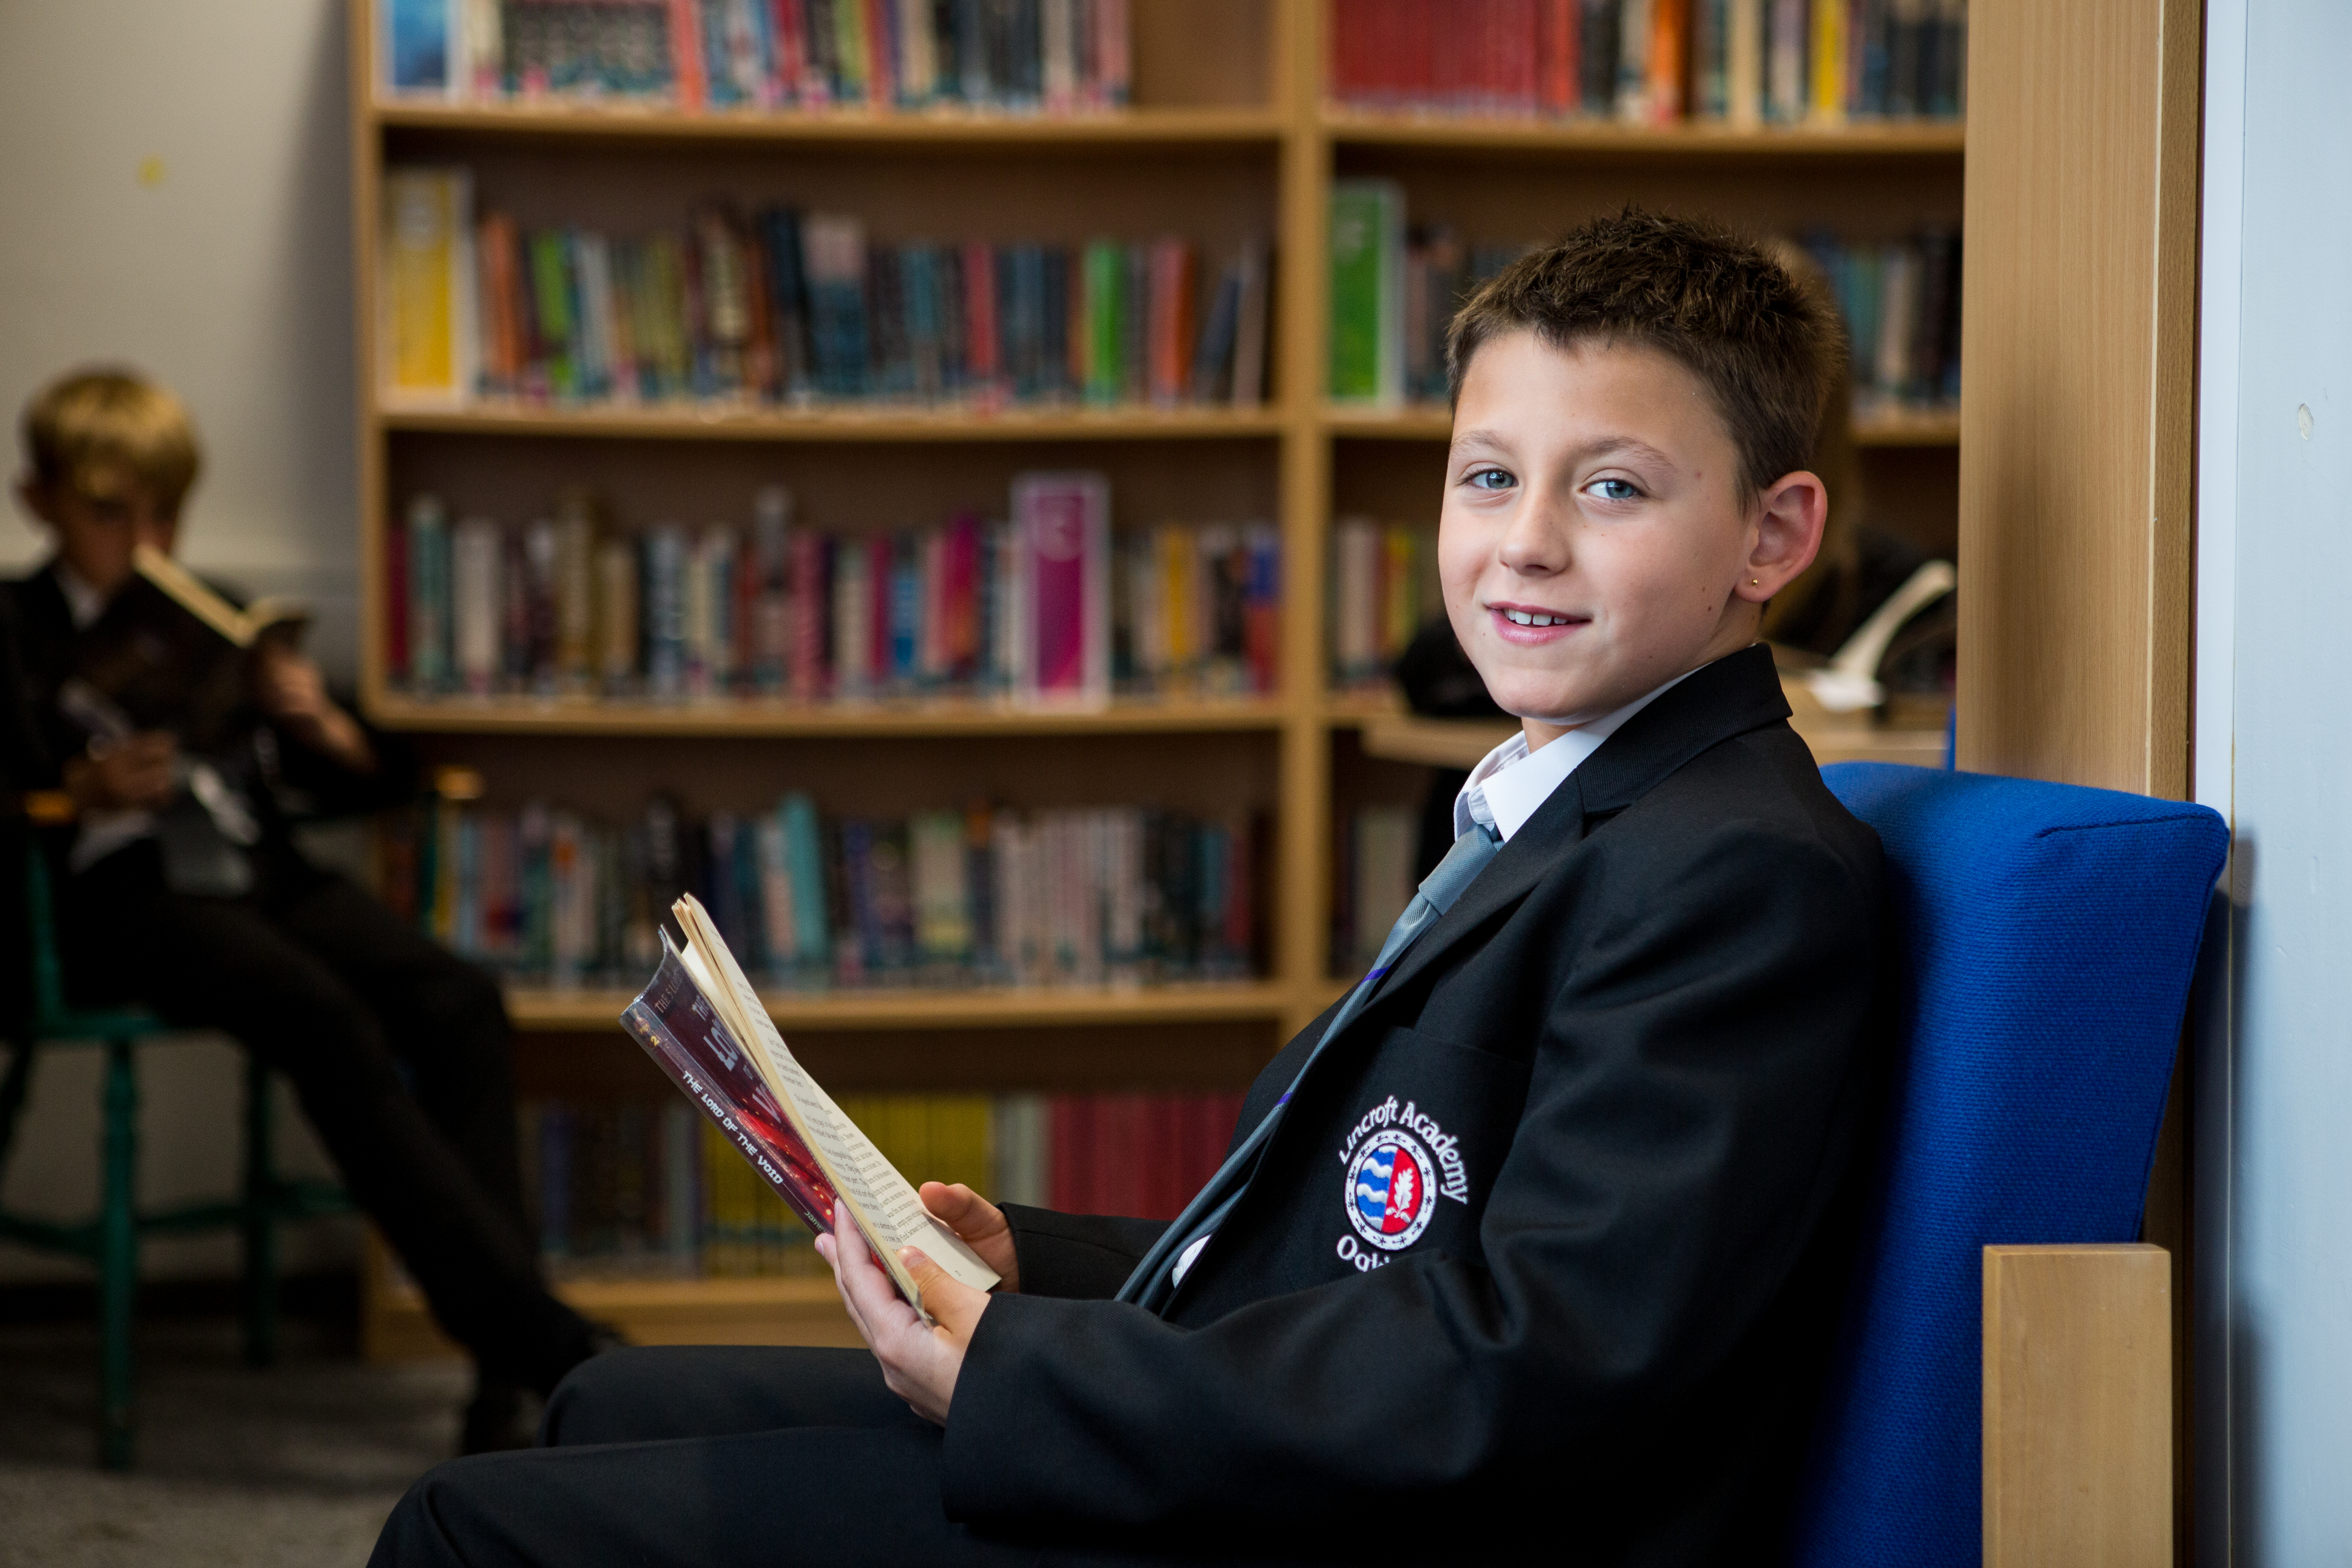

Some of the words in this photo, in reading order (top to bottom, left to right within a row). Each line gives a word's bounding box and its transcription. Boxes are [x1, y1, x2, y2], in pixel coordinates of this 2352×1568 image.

[650, 1035, 660, 1046] 2
[682, 1070, 703, 1094] THE
[701, 1093, 724, 1118] LORD
[723, 1117, 738, 1132] OF
[737, 1132, 758, 1156] THE
[757, 1155, 784, 1184] VOID
[1338, 1094, 1398, 1165] Lincroft
[1398, 1101, 1468, 1205] Academy
[803, 1211, 828, 1232] Jame
